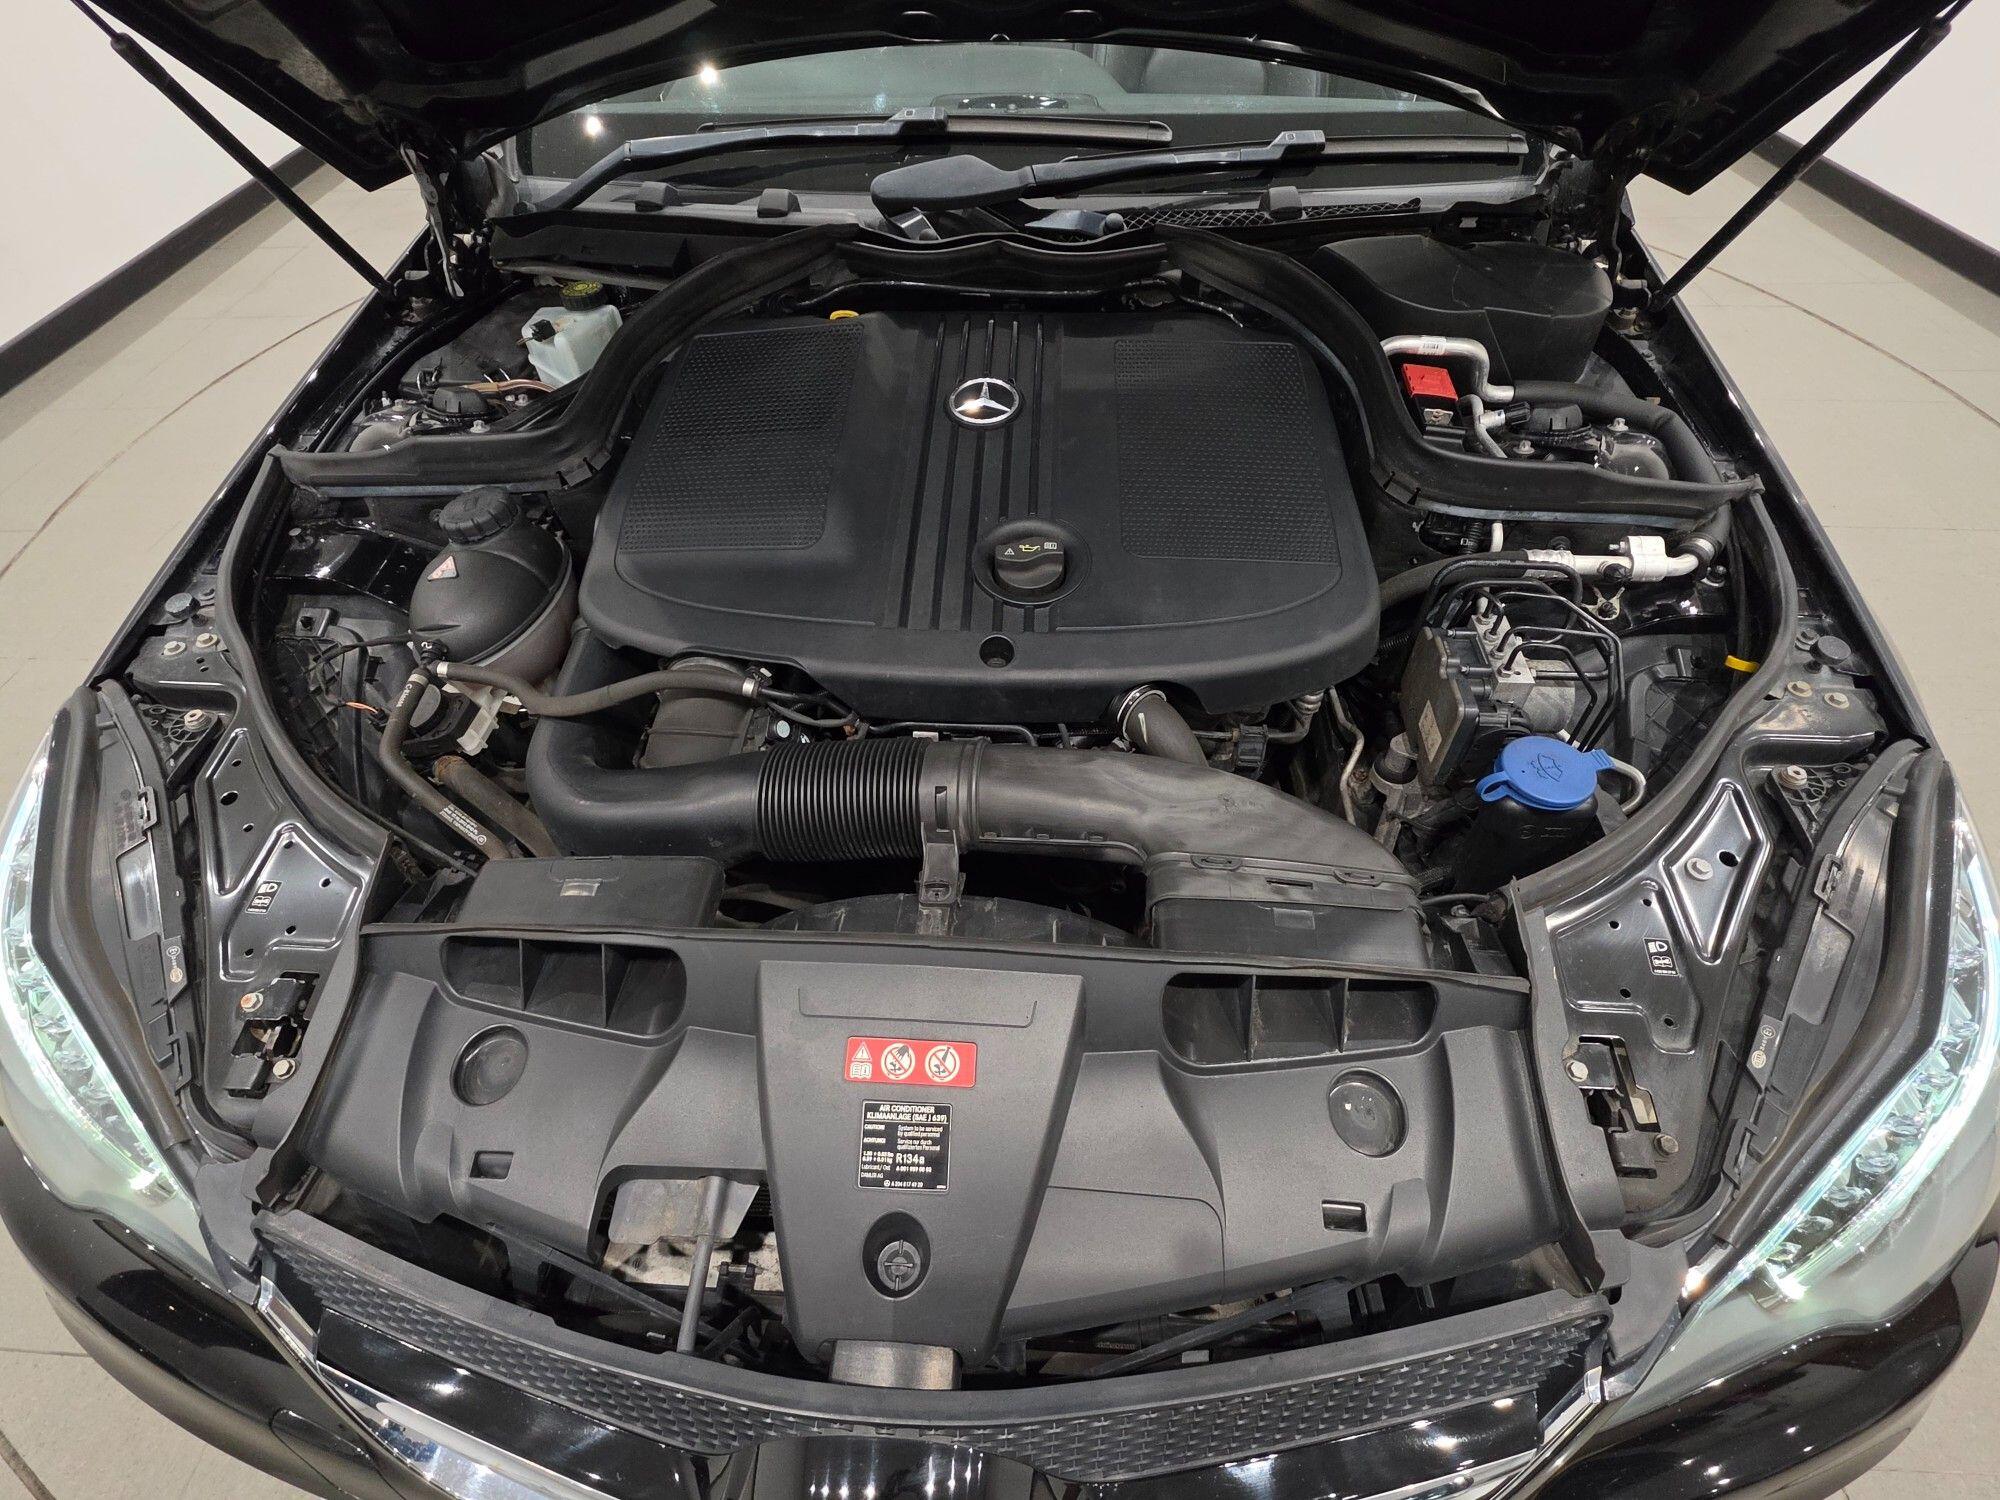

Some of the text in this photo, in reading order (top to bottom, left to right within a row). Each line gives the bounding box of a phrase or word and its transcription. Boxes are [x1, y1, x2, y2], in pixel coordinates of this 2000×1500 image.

[891, 1105, 935, 1114] CONDITIONER
[866, 1112, 912, 1120] KLIMAANLAGE
[912, 1114, 927, 1122] (SAE
[932, 1114, 947, 1123] 639)
[896, 1152, 925, 1165] R134a
